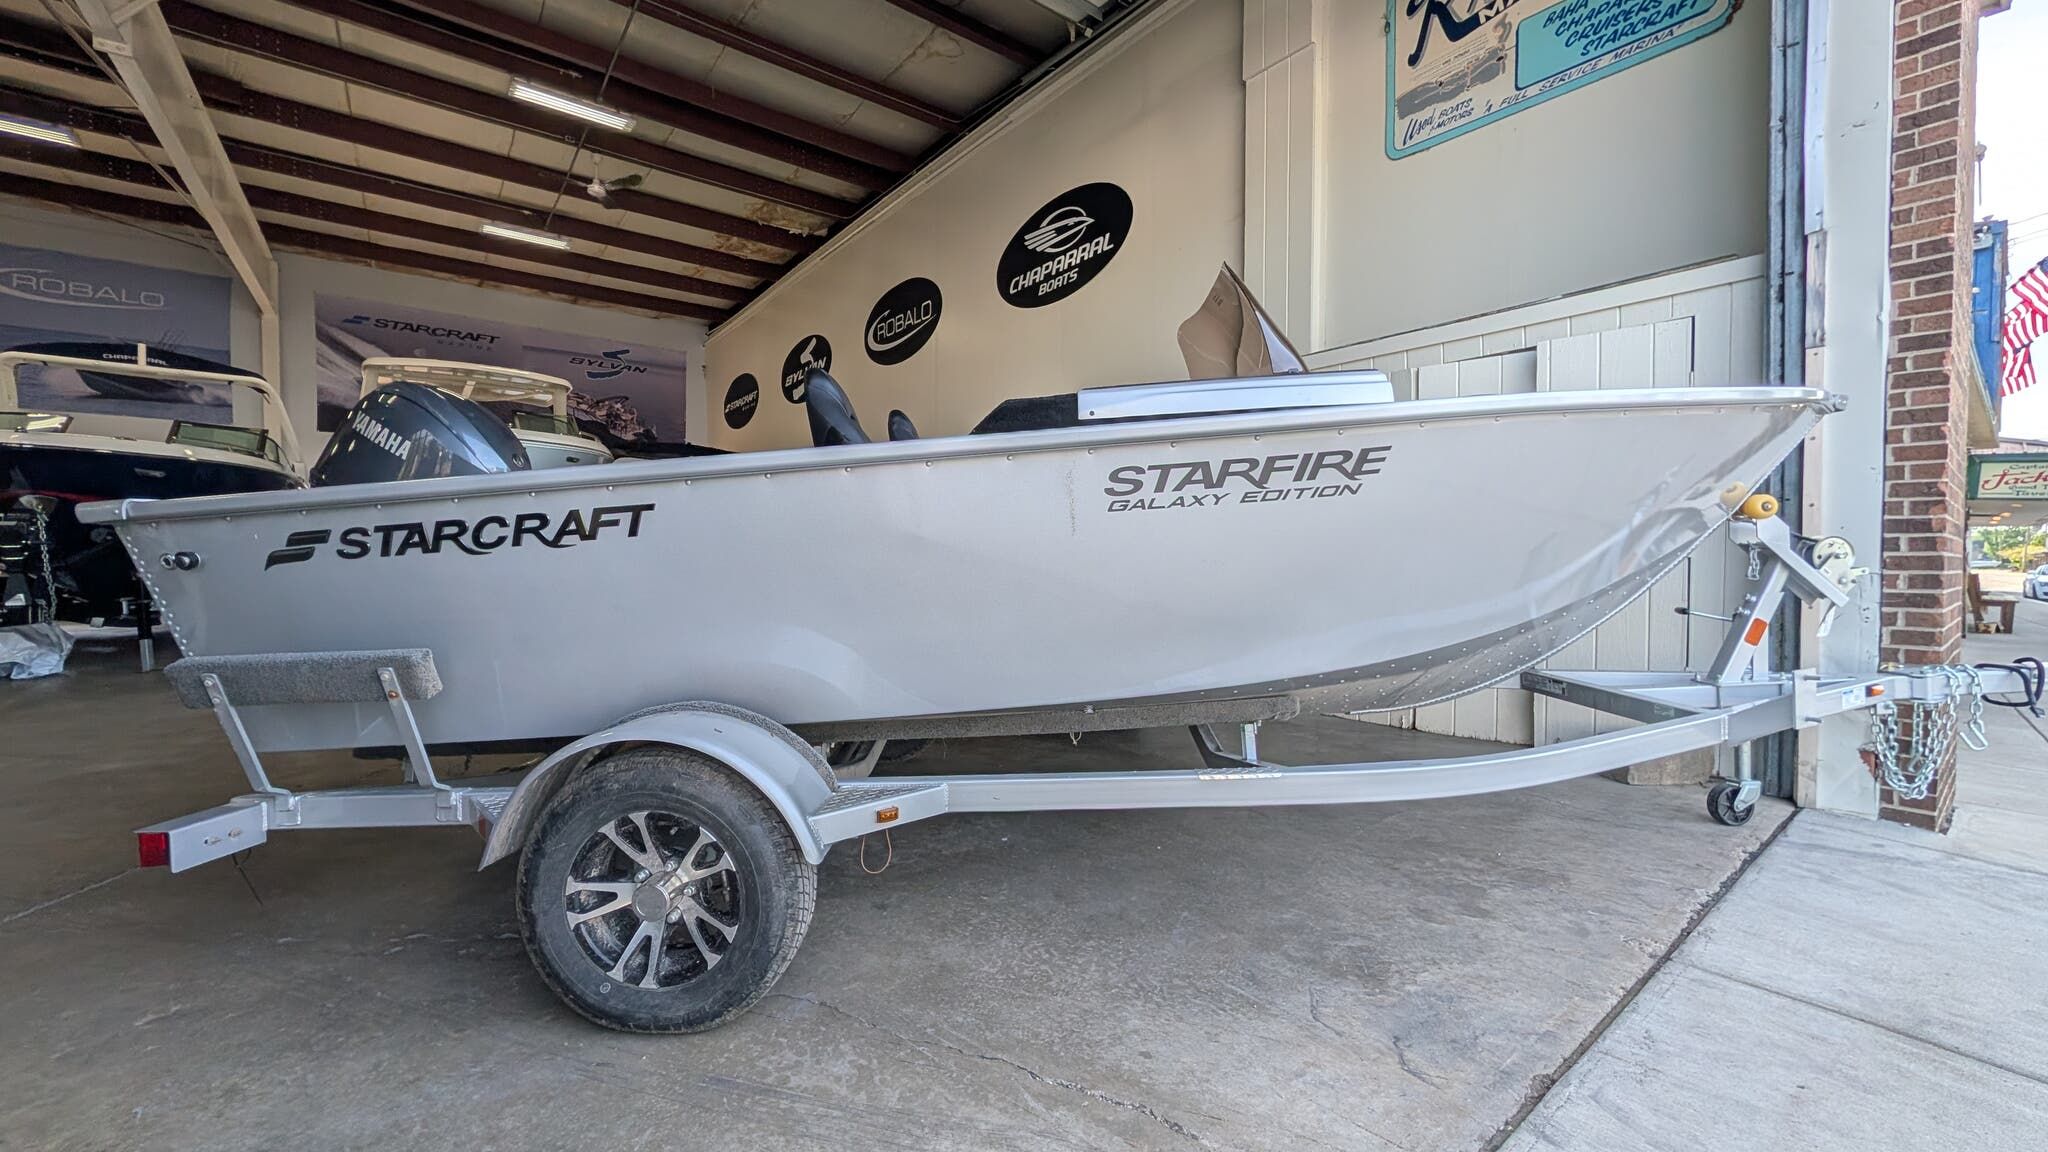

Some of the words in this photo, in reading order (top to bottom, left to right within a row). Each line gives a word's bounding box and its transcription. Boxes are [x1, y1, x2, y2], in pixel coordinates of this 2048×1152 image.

[1555, 0, 1630, 37] CHAPA
[1565, 0, 1663, 47] CRUISERS
[1498, 90, 1529, 107] FULL
[1539, 58, 1603, 91] SERVICE
[1403, 108, 1436, 146] Used
[1438, 98, 1473, 119] BOATS
[1009, 232, 1114, 294] CHAPARRAL
[1038, 268, 1079, 296] BOATS
[11, 273, 165, 307] ROBALO
[373, 318, 501, 344] STARCRAFT
[877, 300, 933, 341] ROBALO
[102, 353, 169, 366] CHAPARAL
[568, 356, 648, 375] SYLVAN
[785, 356, 827, 388] SYLAN
[352, 410, 412, 460] YAMAHA
[1104, 445, 1392, 497] STARFIRE
[1107, 492, 1231, 513] GALAXY
[1240, 483, 1363, 504] EDITION
[336, 503, 656, 560] STARCRAFT
